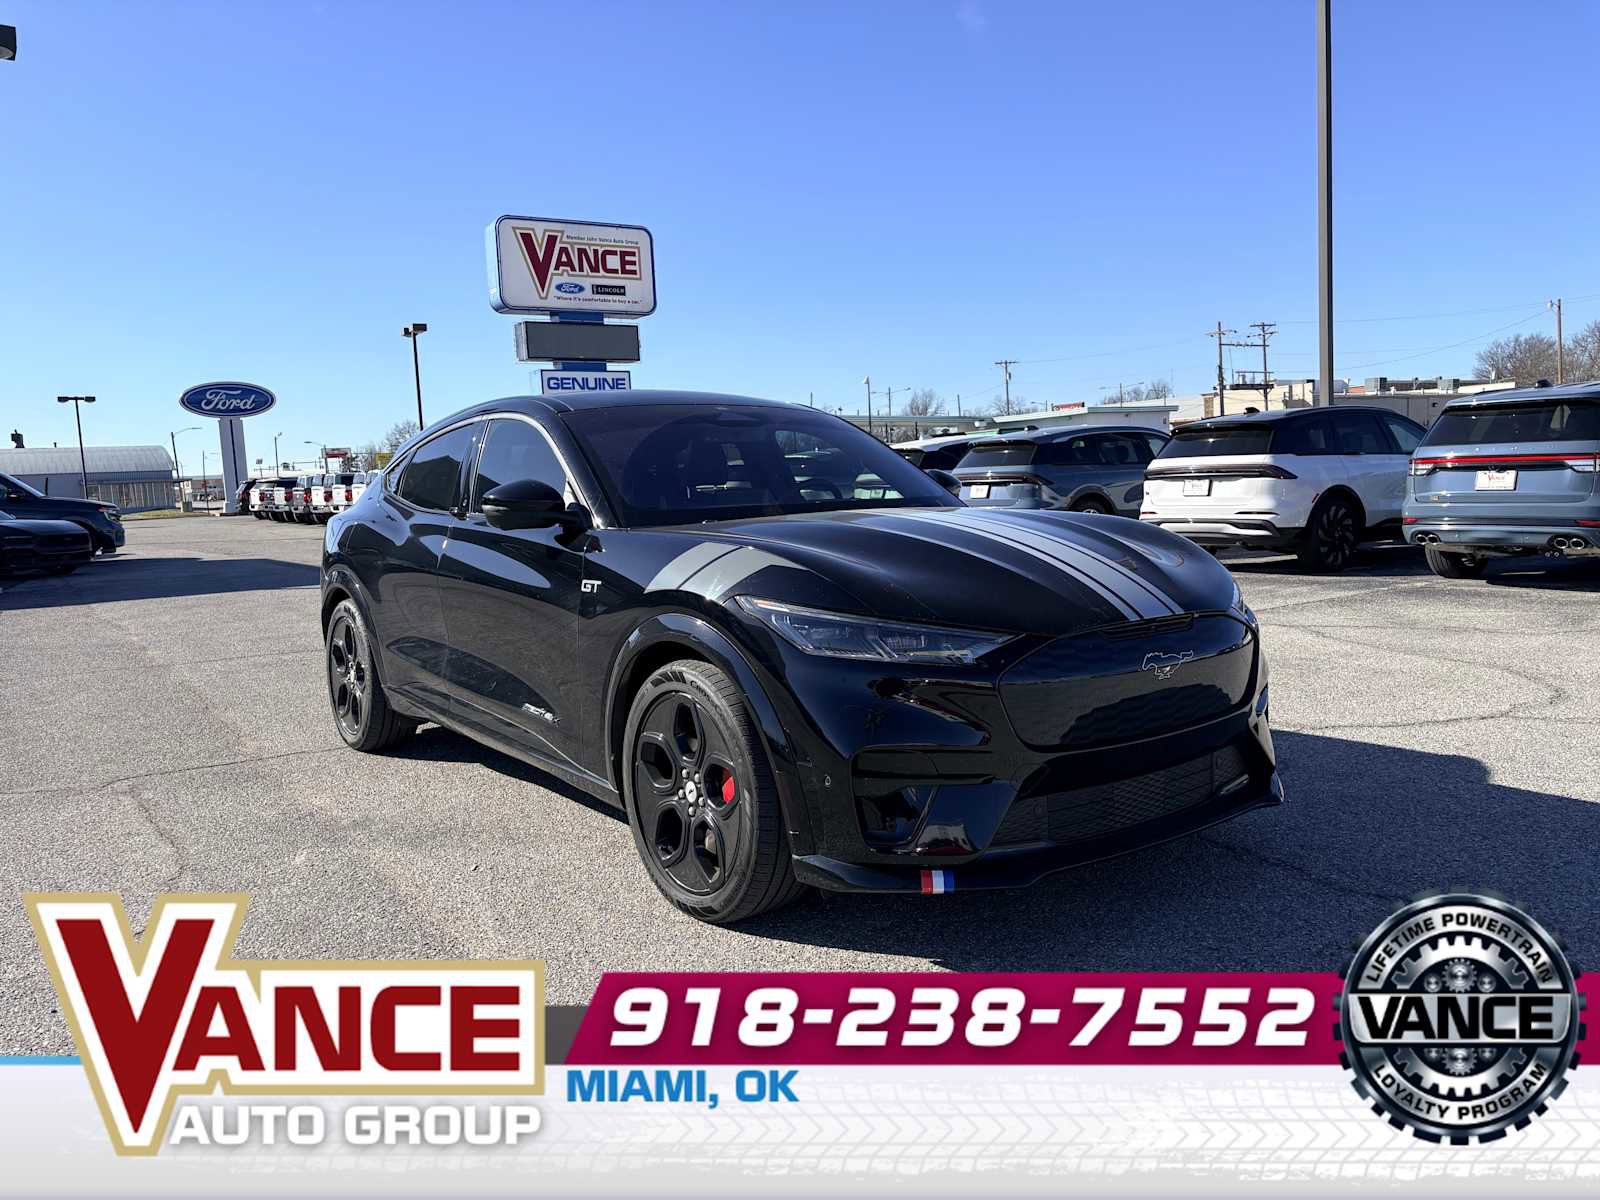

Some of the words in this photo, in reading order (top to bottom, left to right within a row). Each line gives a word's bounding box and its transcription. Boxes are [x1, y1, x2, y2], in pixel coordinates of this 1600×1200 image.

[519, 232, 638, 294] VANCE
[560, 284, 579, 293] Ford
[547, 377, 626, 391] GENUINE
[201, 389, 256, 410] Ford
[581, 579, 602, 593] GT
